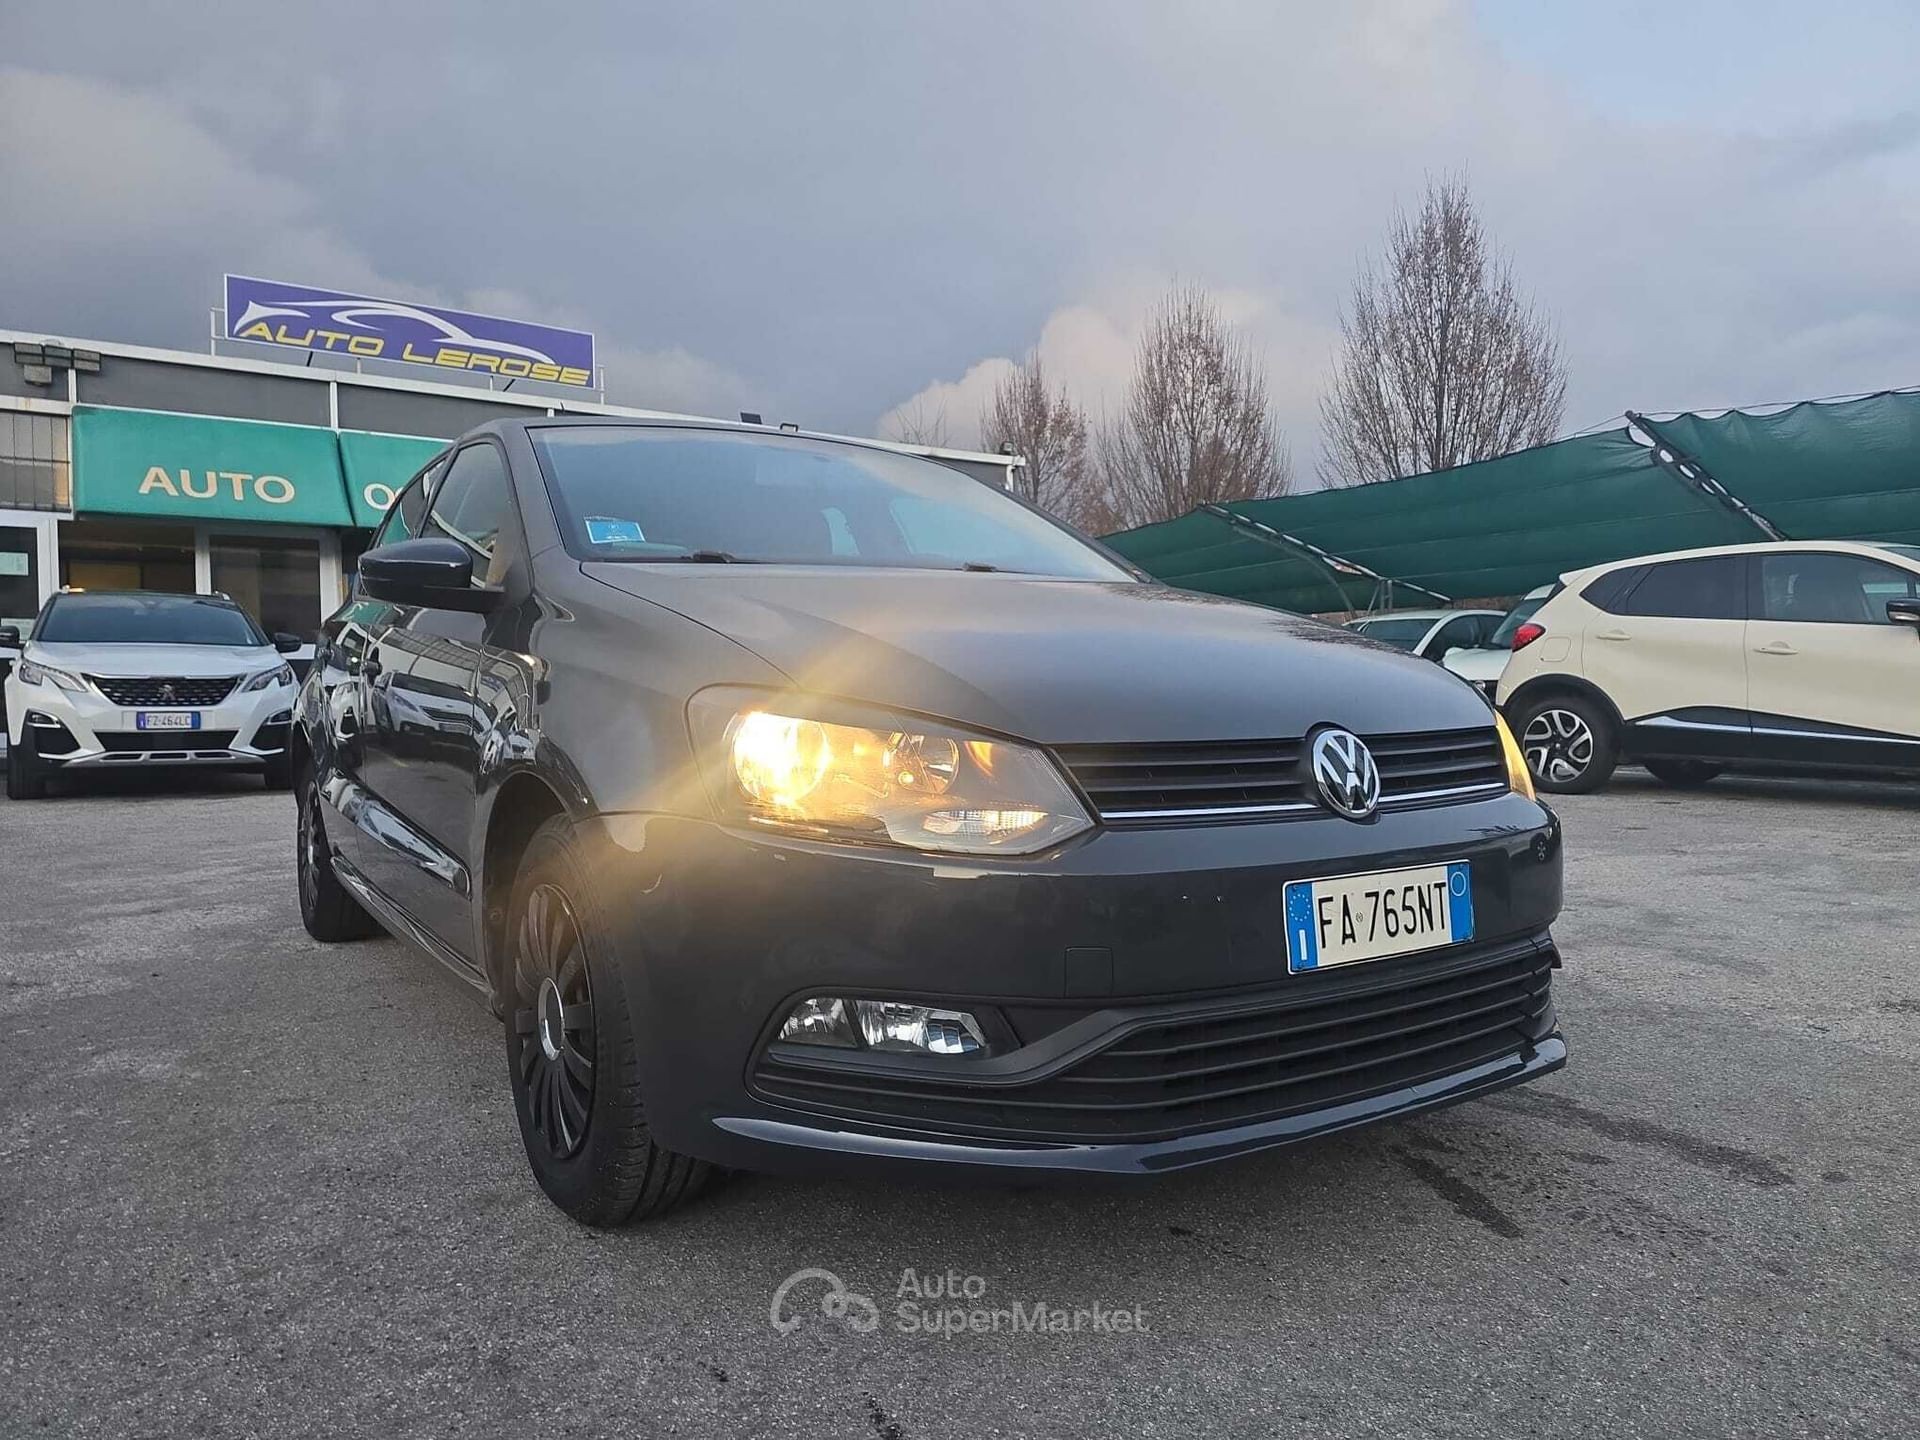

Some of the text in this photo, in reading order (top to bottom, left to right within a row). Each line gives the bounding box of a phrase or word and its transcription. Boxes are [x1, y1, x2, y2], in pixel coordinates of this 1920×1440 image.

[239, 322, 590, 386] AUTO LEROSE
[138, 466, 404, 511] AUTO O
